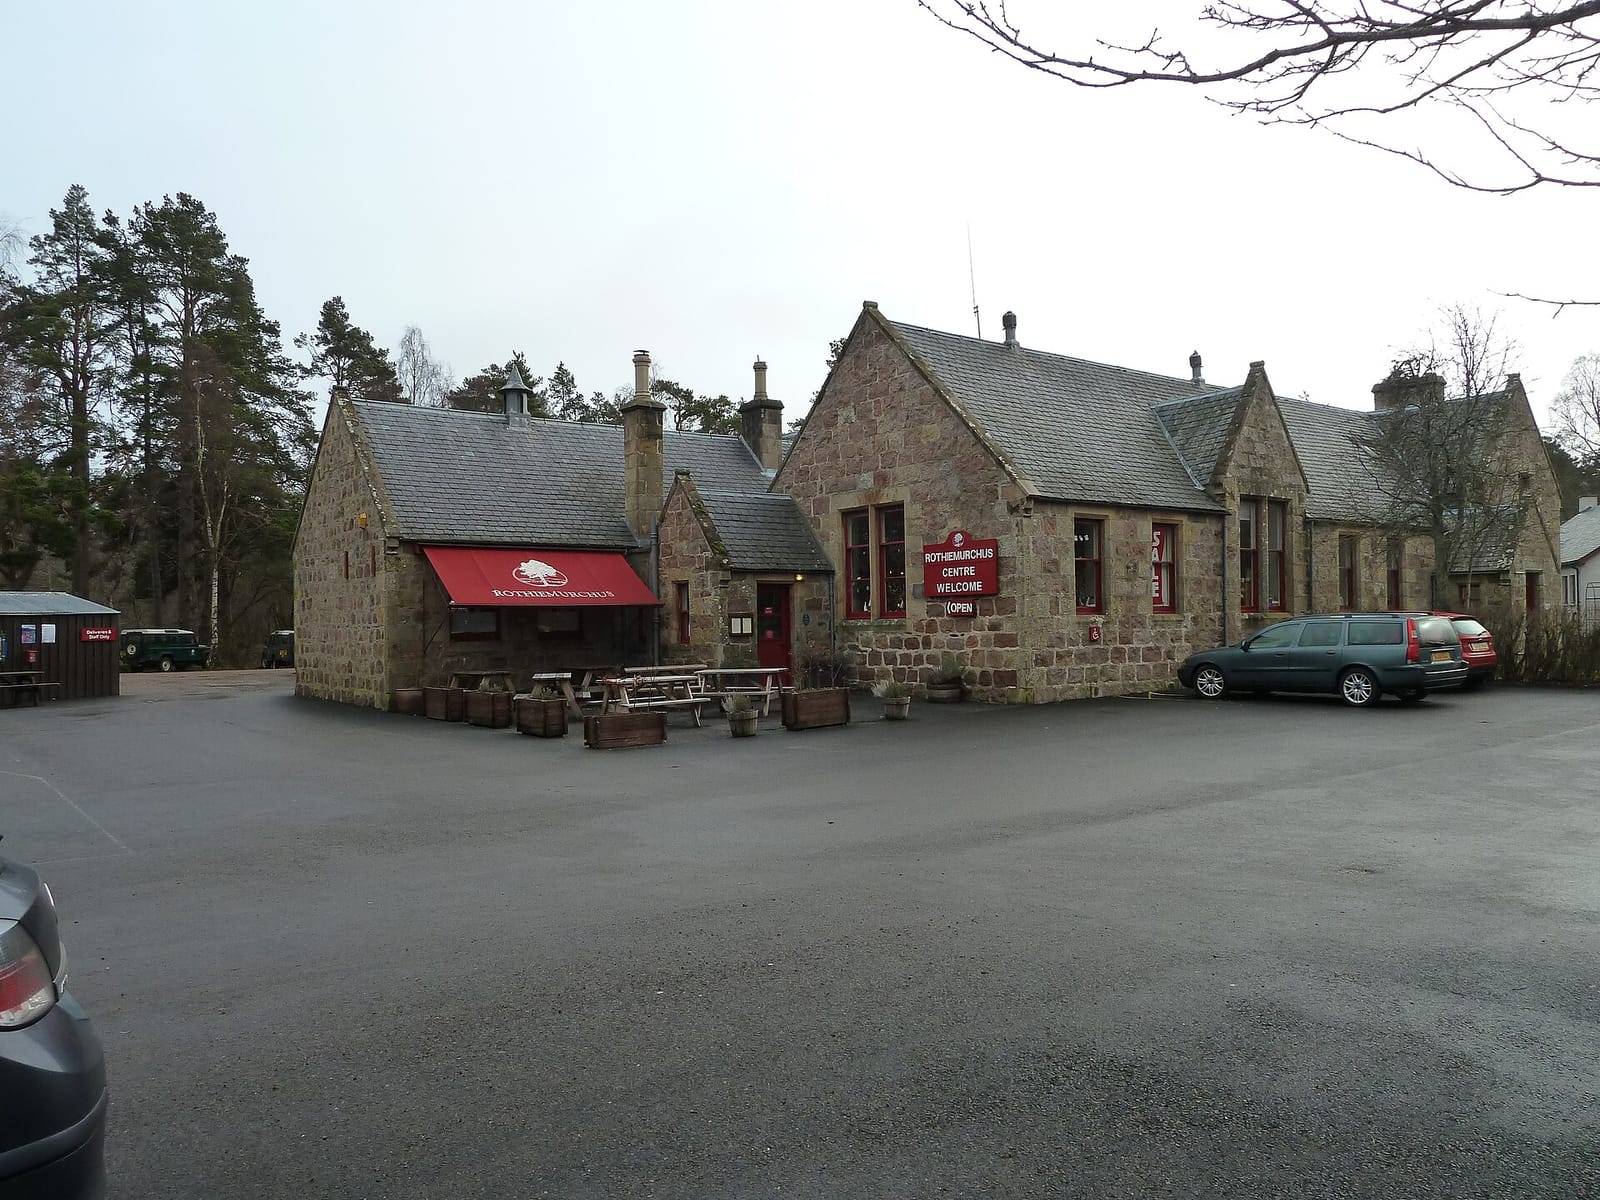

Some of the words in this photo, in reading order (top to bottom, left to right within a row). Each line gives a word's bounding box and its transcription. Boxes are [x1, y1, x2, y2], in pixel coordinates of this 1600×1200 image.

[925, 548, 994, 563] ROTHIEMURCHUS
[1151, 531, 1161, 597] SALE
[942, 566, 976, 578] CENTRE
[936, 581, 983, 593] WELCOME
[491, 589, 615, 598] ROTHIEMURCHUS
